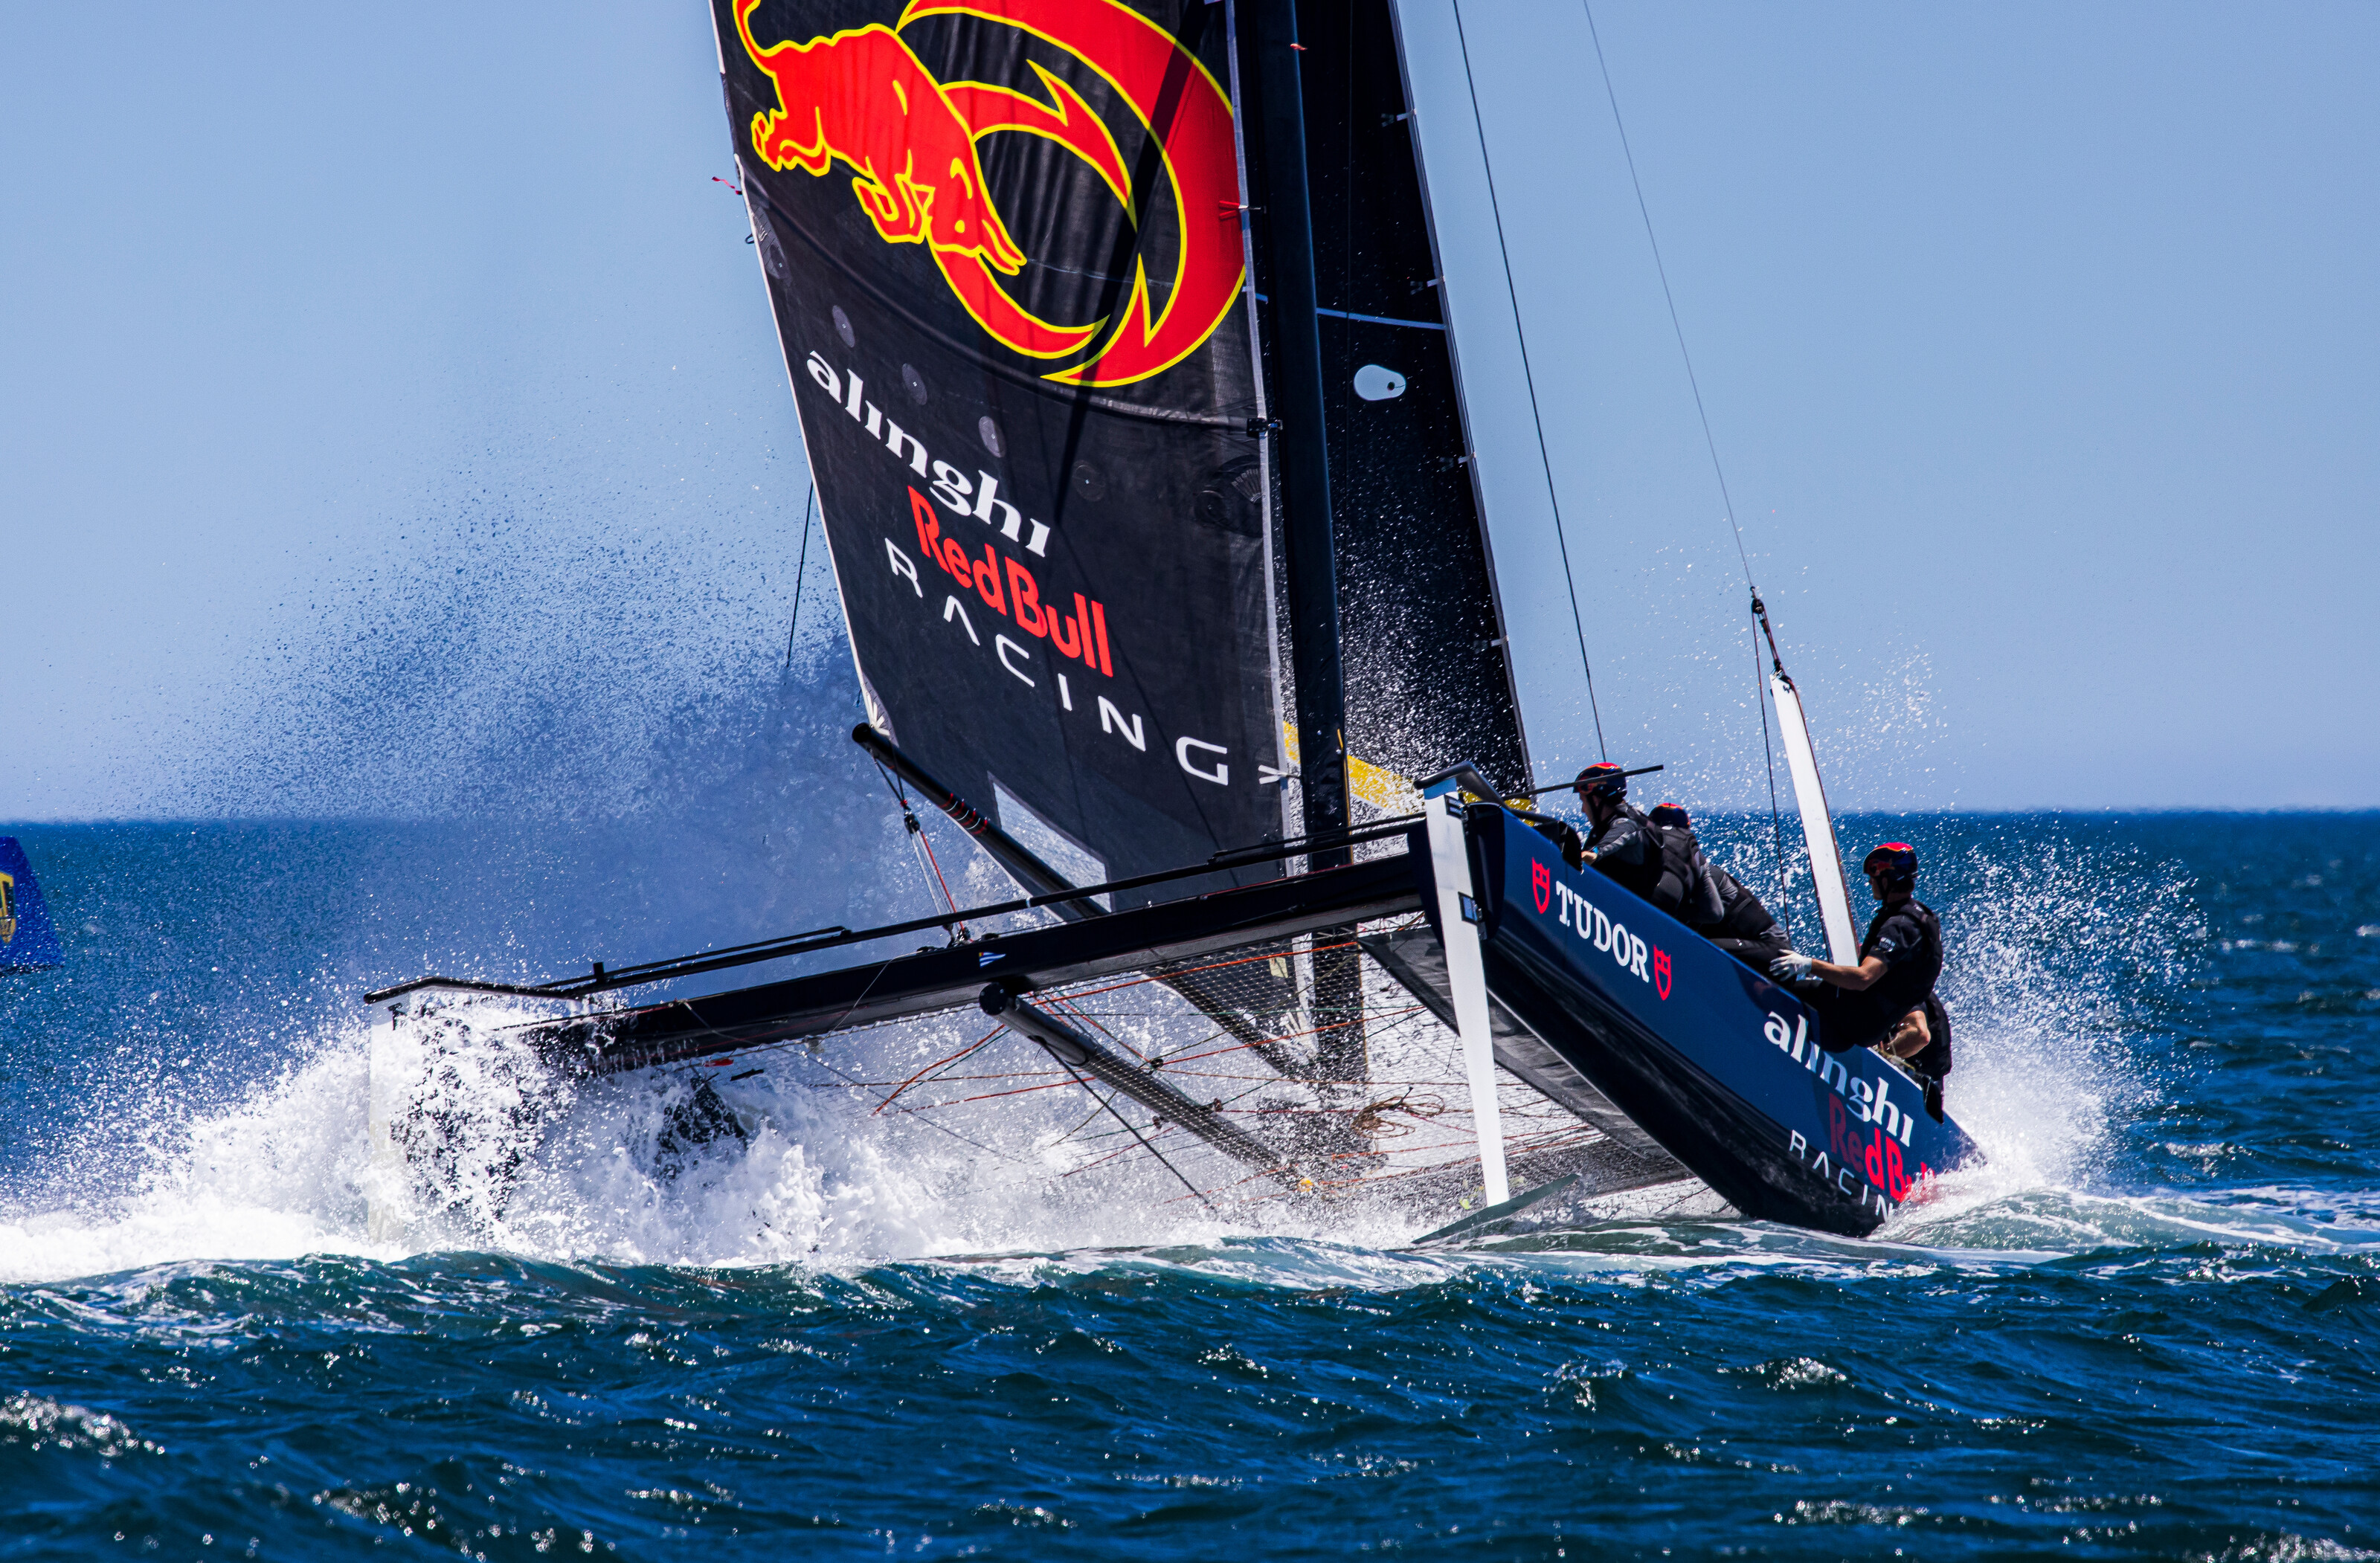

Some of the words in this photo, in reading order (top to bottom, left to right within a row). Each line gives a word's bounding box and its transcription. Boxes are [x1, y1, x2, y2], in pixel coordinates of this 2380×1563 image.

[884, 537, 1229, 787] RACING
[1555, 880, 1650, 983] TUDOR
[1789, 1129, 1895, 1223] RACIN
